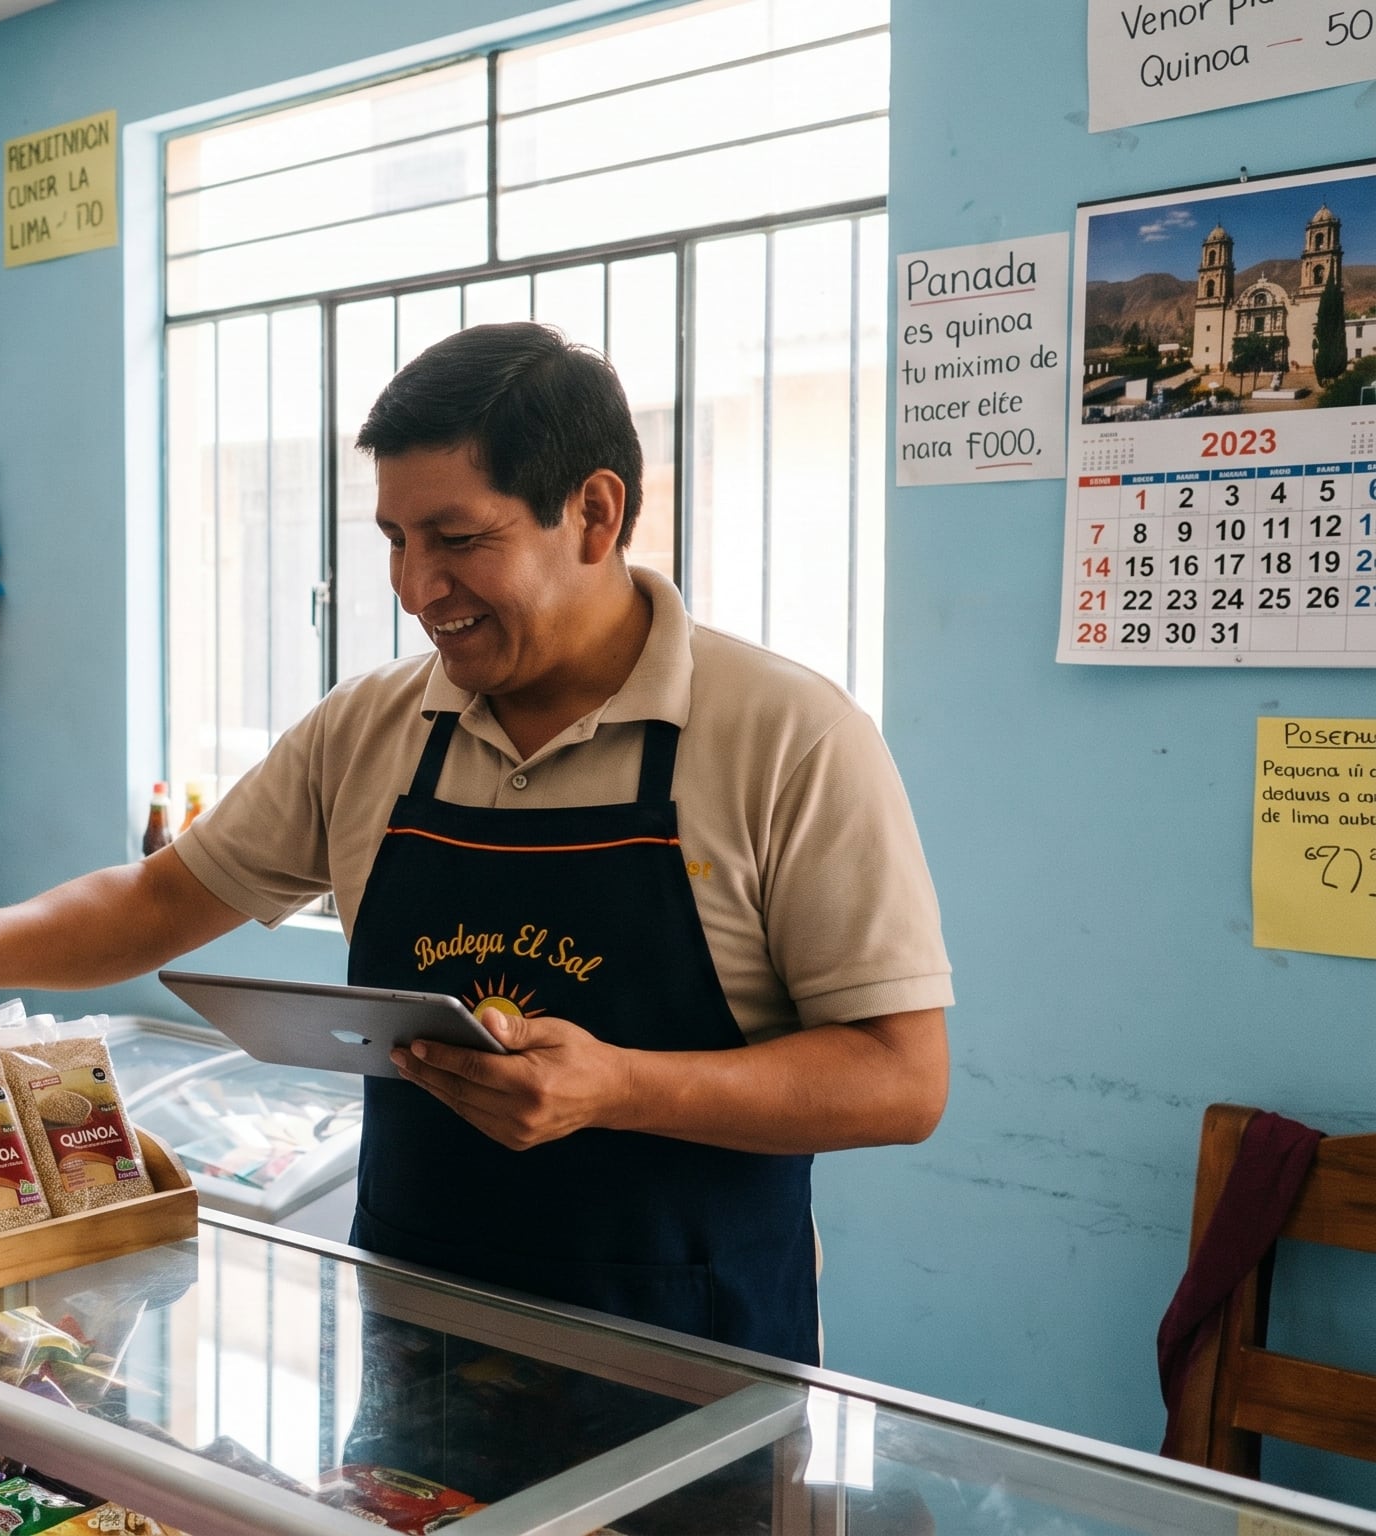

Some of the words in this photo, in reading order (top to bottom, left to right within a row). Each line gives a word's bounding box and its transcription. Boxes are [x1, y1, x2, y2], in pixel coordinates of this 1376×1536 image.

[1140, 44, 1250, 87] Quinoa
[1324, 9, 1374, 47] 50
[68, 166, 90, 192] LA
[9, 215, 52, 250] LIMA
[907, 251, 1036, 301] Panada
[903, 322, 933, 344] es
[945, 312, 1033, 348] quinoa
[902, 360, 926, 385] tu
[934, 354, 1020, 380] miximo
[1029, 344, 1058, 369] de
[1200, 428, 1278, 458] 2023
[1135, 489, 1146, 510] 1
[1179, 487, 1194, 508] 2
[1224, 484, 1240, 506] 3
[1270, 482, 1287, 504] 4
[1319, 480, 1336, 502] 5
[1090, 524, 1105, 545] 7
[1133, 523, 1147, 544] 8
[1177, 521, 1192, 542] 9
[1215, 519, 1246, 541] 10
[1263, 517, 1290, 539] 11
[1310, 514, 1342, 537] 12
[1082, 556, 1111, 577] 14
[1125, 556, 1154, 577] 15
[1169, 554, 1199, 576] 16
[1214, 553, 1246, 575] 17
[1260, 552, 1292, 574] 18
[1308, 551, 1341, 573] 19
[1078, 590, 1107, 611] 21
[1122, 590, 1152, 610] 22
[1166, 589, 1198, 610] 23
[1211, 588, 1244, 610] 24
[1258, 587, 1291, 609] 25
[1306, 586, 1340, 609] 26
[1077, 623, 1107, 643] 28
[1120, 622, 1151, 643] 29
[1165, 622, 1196, 643] 30
[1210, 622, 1240, 644] 31
[1261, 808, 1281, 823] de
[1292, 808, 1330, 825] lima
[414, 923, 506, 972] Bodega
[513, 924, 548, 959] El
[548, 936, 604, 982] Sol
[60, 1125, 119, 1148] QUINOA
